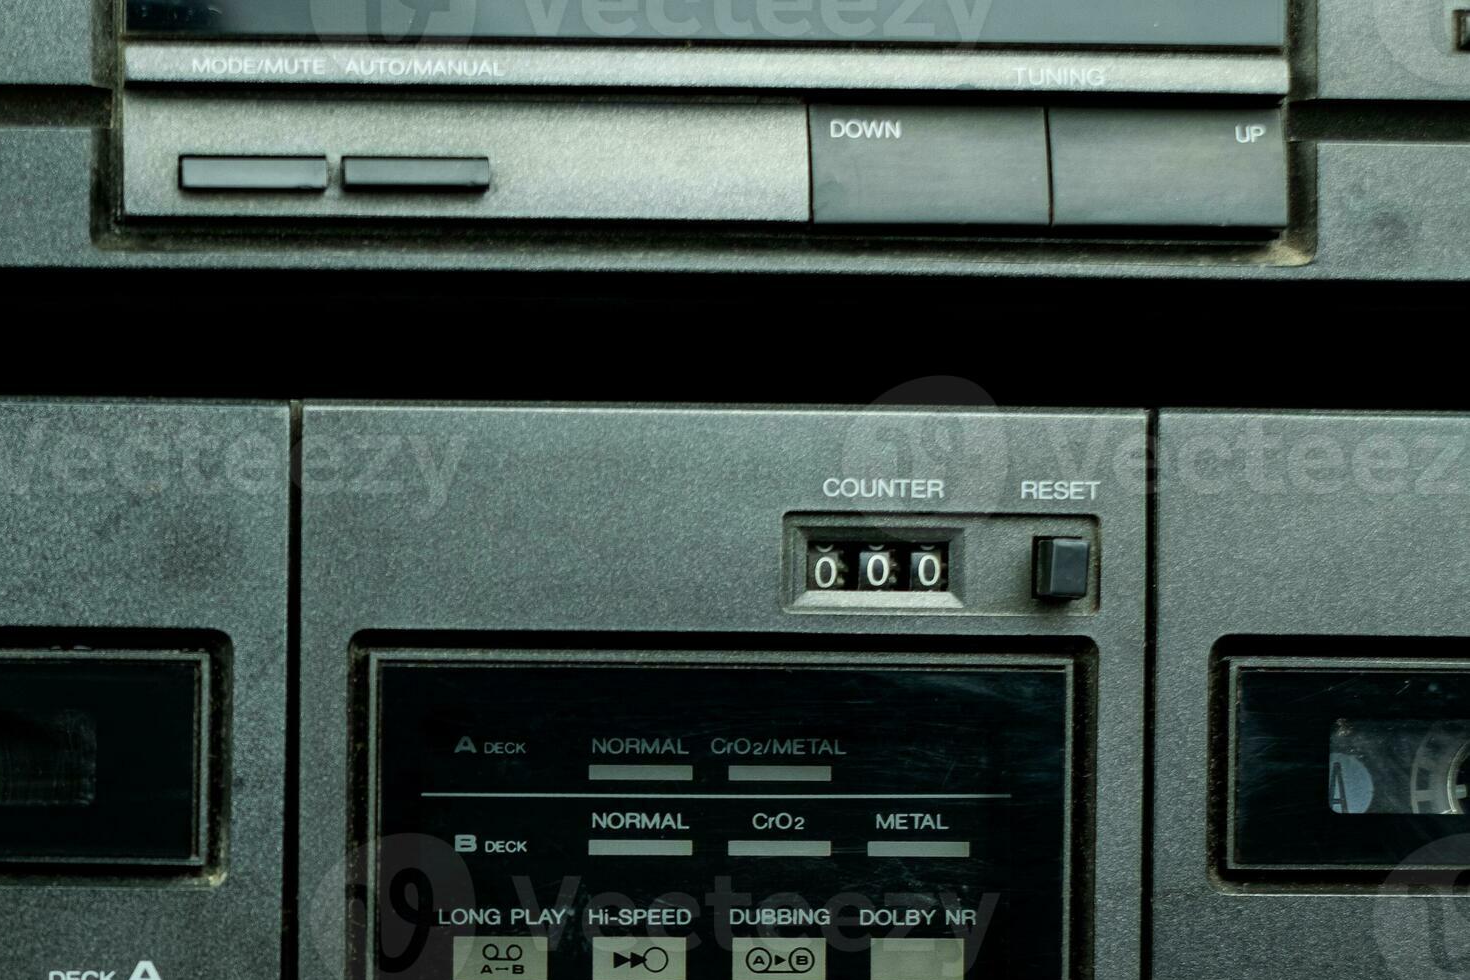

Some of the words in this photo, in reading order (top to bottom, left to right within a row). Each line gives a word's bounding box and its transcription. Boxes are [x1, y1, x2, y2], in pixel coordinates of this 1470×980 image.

[192, 56, 325, 76] MODE/MUTE
[345, 57, 505, 78] AUTO/MANUAL
[1013, 67, 1106, 88] TUNING
[830, 120, 902, 139] DOWN
[1235, 125, 1266, 144] UP
[822, 479, 945, 499] COUNTER
[1020, 481, 1100, 500] RESET
[454, 736, 477, 755] A
[484, 741, 527, 755] DECK
[591, 737, 690, 756] NORMAL
[591, 812, 690, 830] NORMAL
[875, 813, 949, 831] METAL
[454, 834, 478, 852] B
[484, 839, 527, 853] DECK
[438, 908, 500, 926] LONG
[510, 908, 565, 926] PLAY
[588, 907, 692, 926] Hi-SPEED
[730, 907, 831, 927] DUBBING
[859, 908, 935, 927] DOLBY
[944, 909, 977, 927] NR
